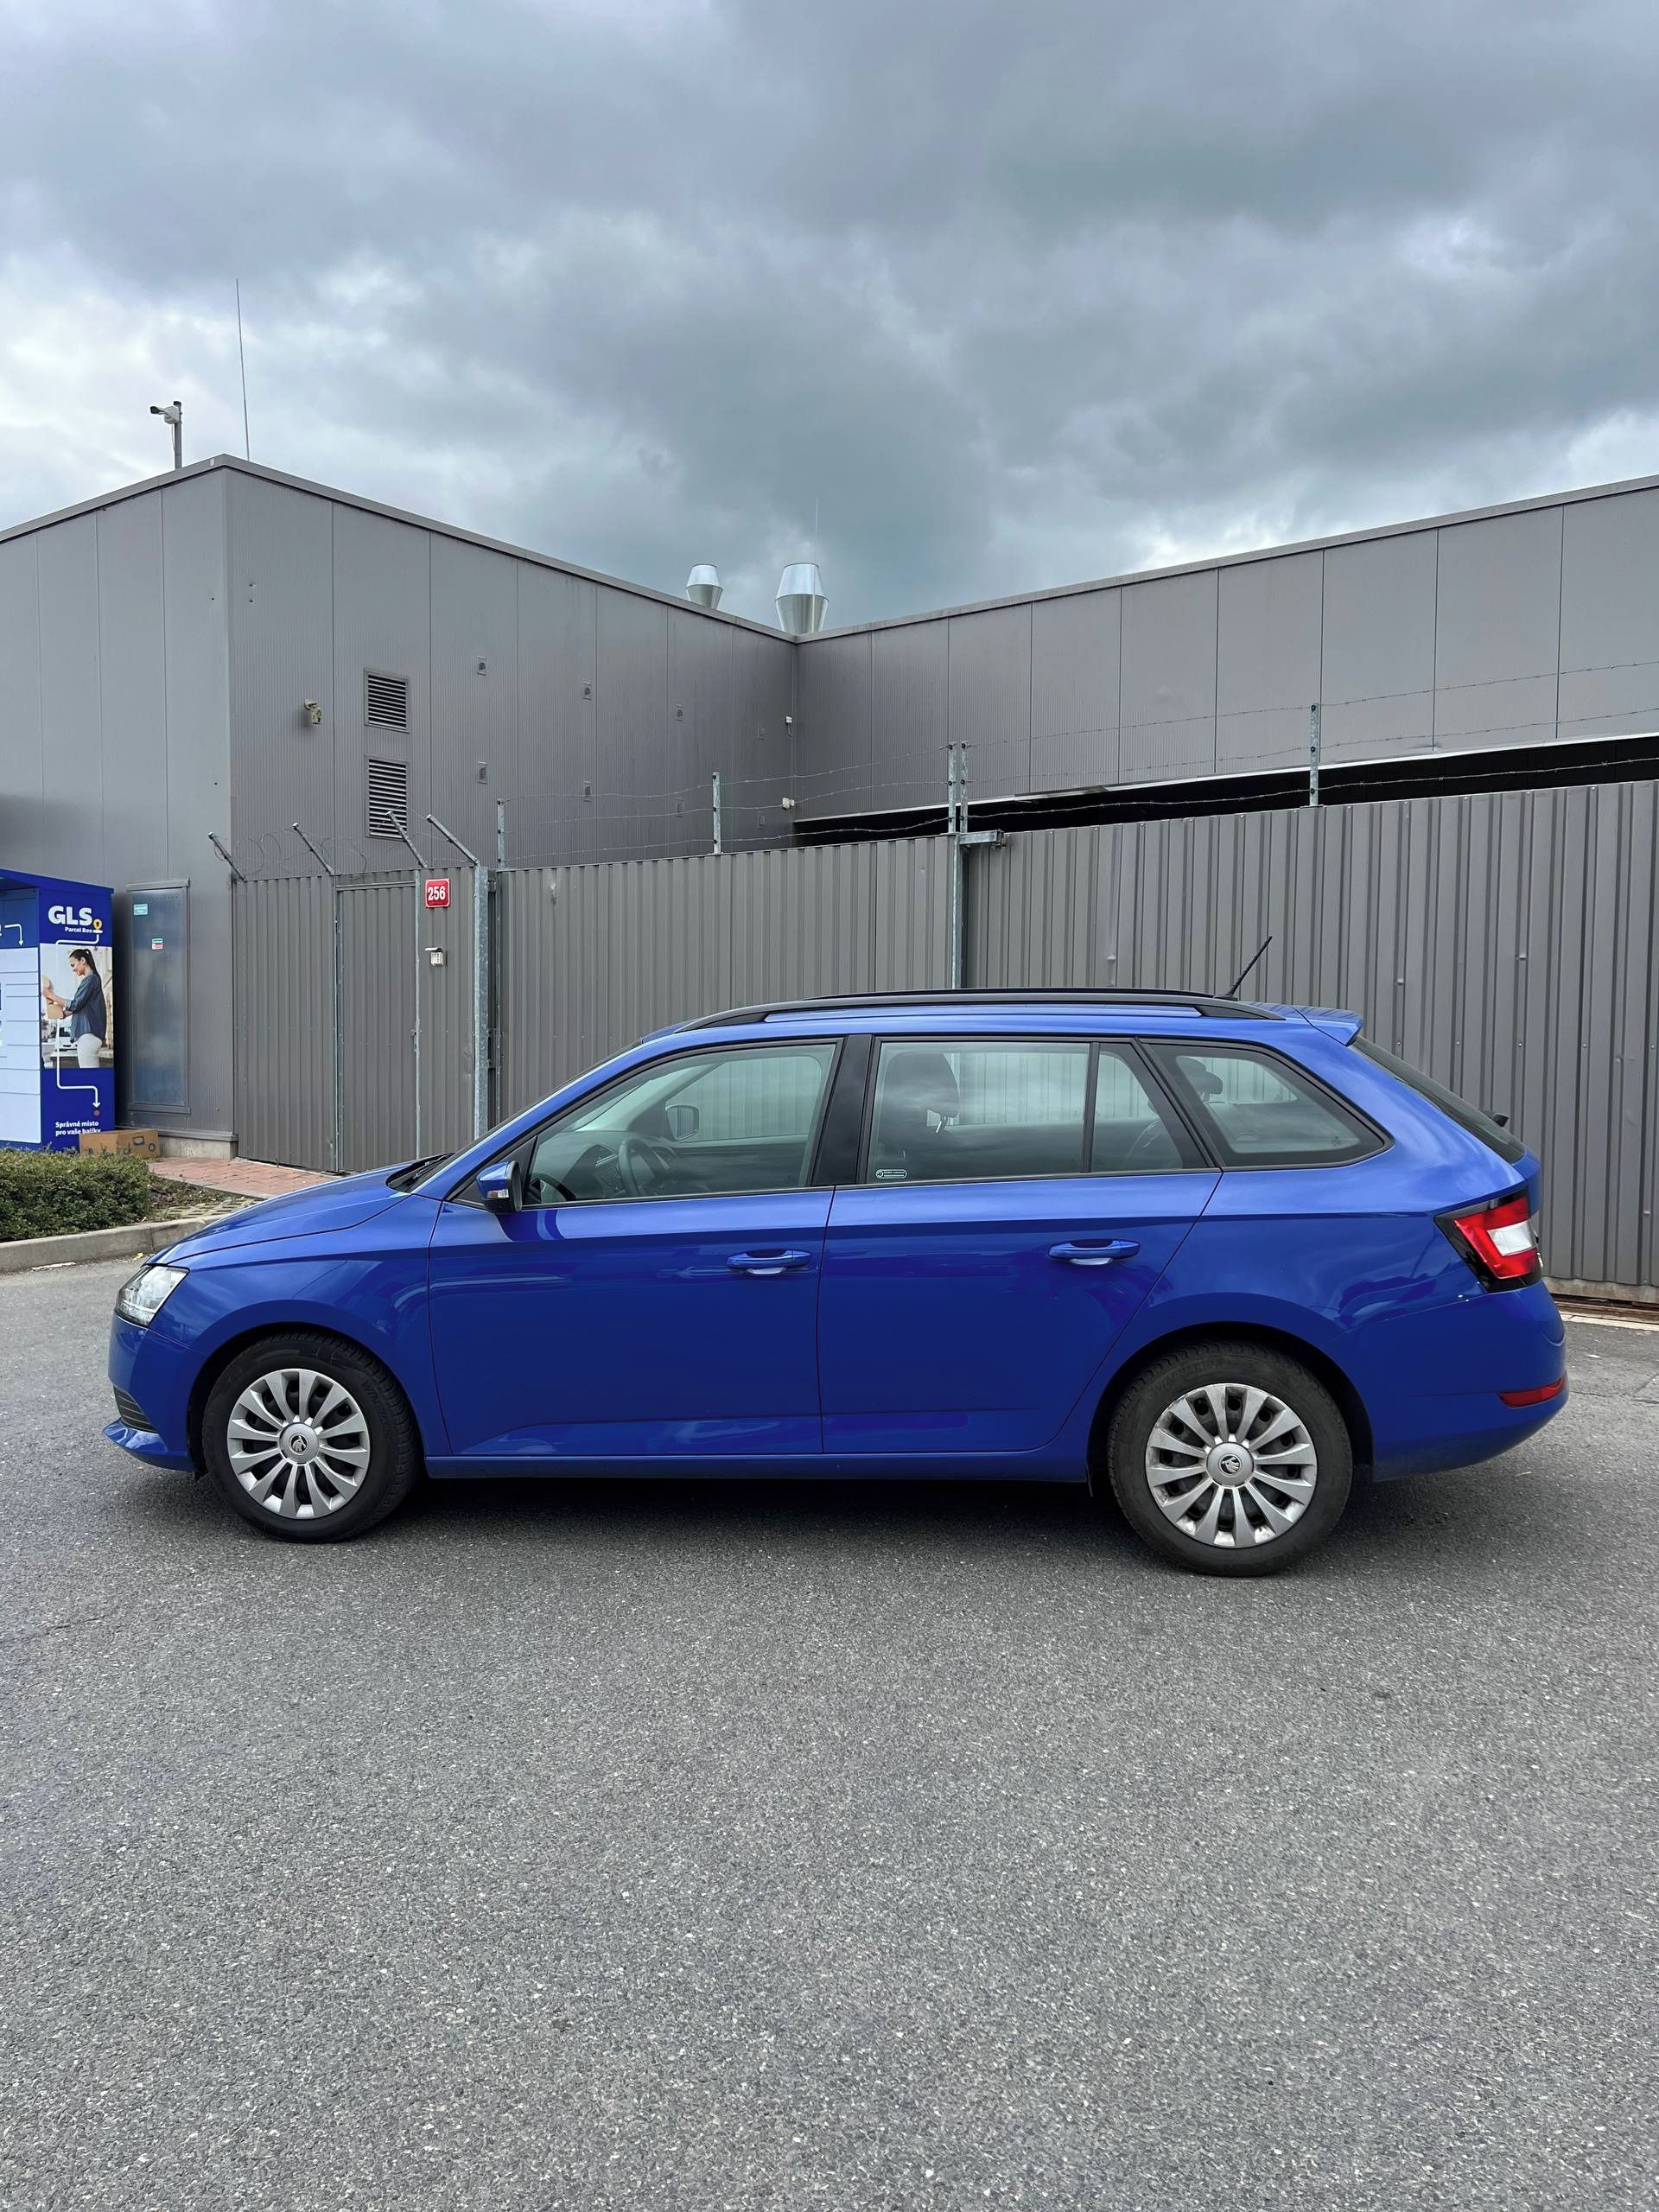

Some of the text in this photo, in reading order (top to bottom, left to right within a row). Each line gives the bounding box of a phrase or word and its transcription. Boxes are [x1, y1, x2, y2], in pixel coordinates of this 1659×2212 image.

[428, 886, 446, 901] 256
[48, 905, 93, 926] GLS
[55, 1120, 81, 1128] Správné
